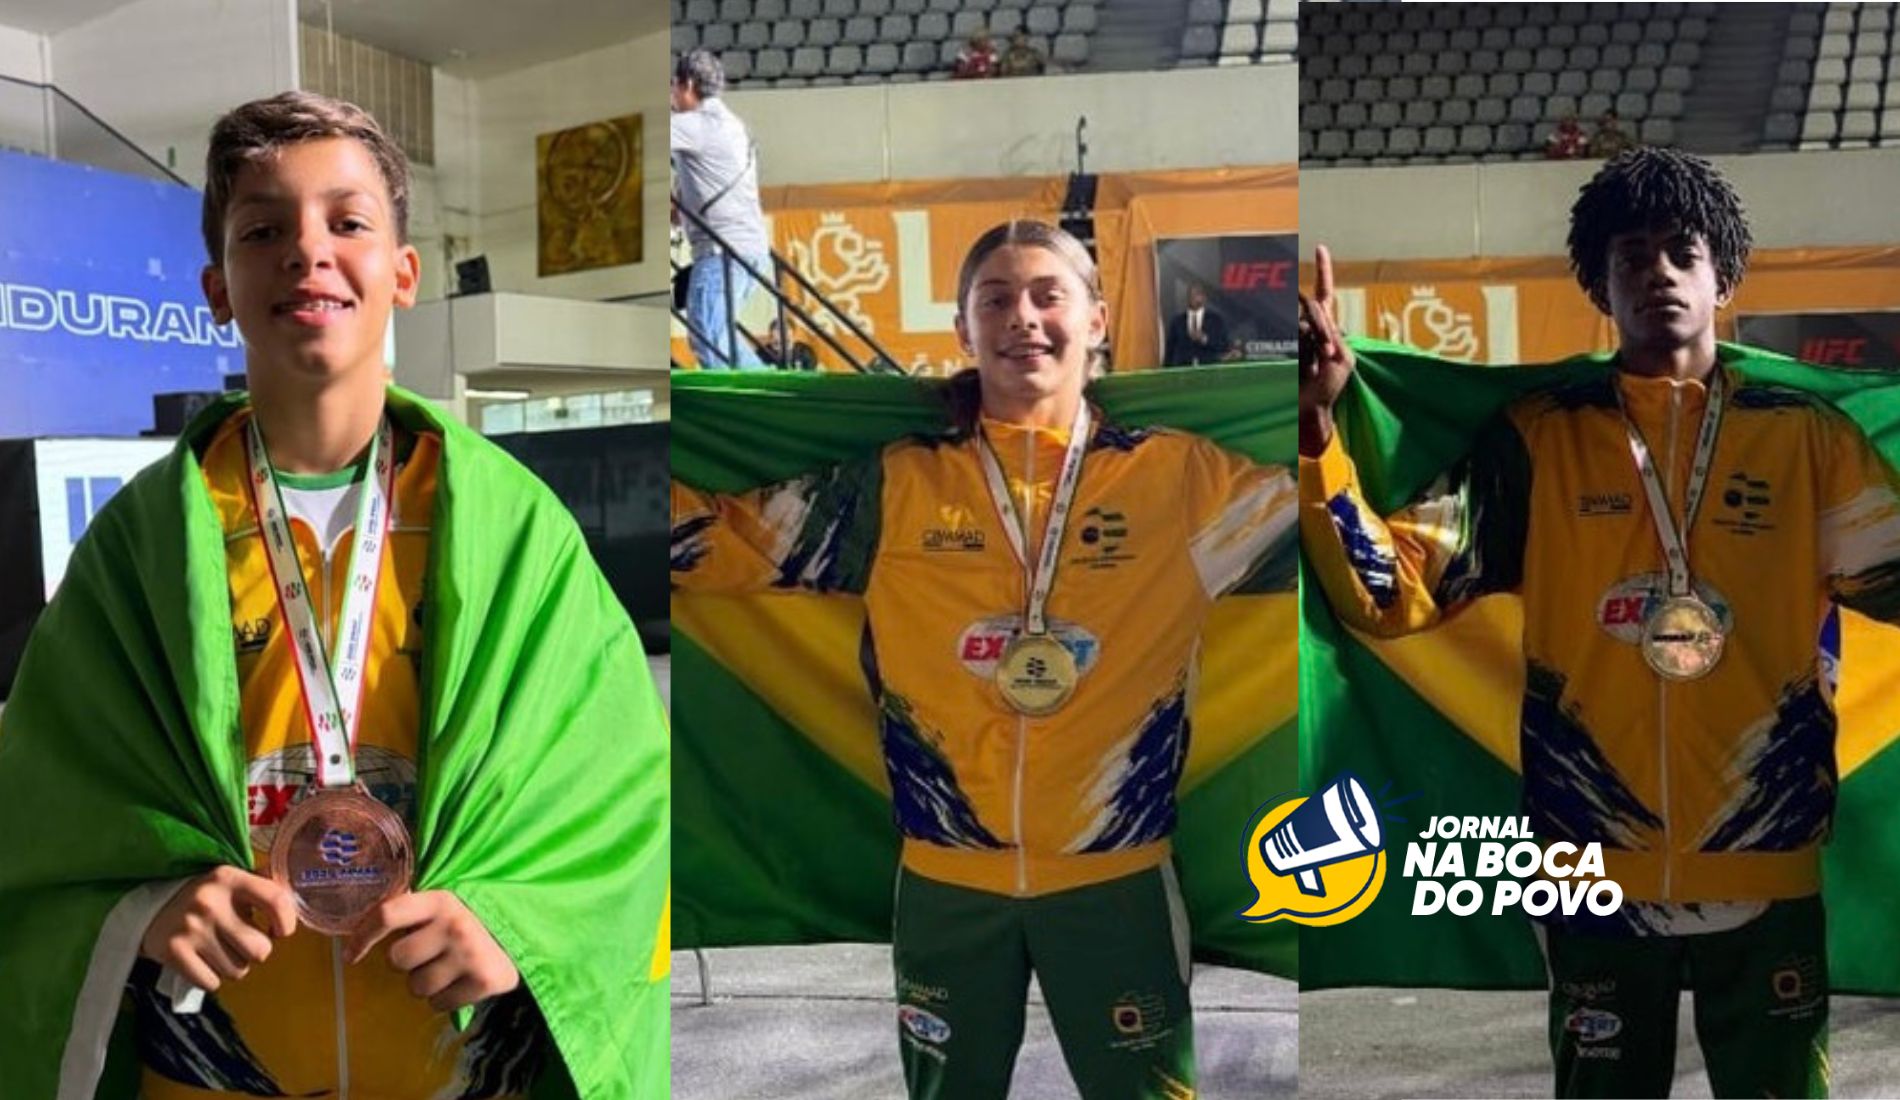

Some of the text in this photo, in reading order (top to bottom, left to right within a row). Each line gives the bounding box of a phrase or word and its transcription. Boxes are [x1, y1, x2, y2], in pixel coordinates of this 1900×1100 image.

[1223, 262, 1291, 289] UFC
[0, 283, 244, 347] DURAN
[1801, 336, 1867, 364] UFC
